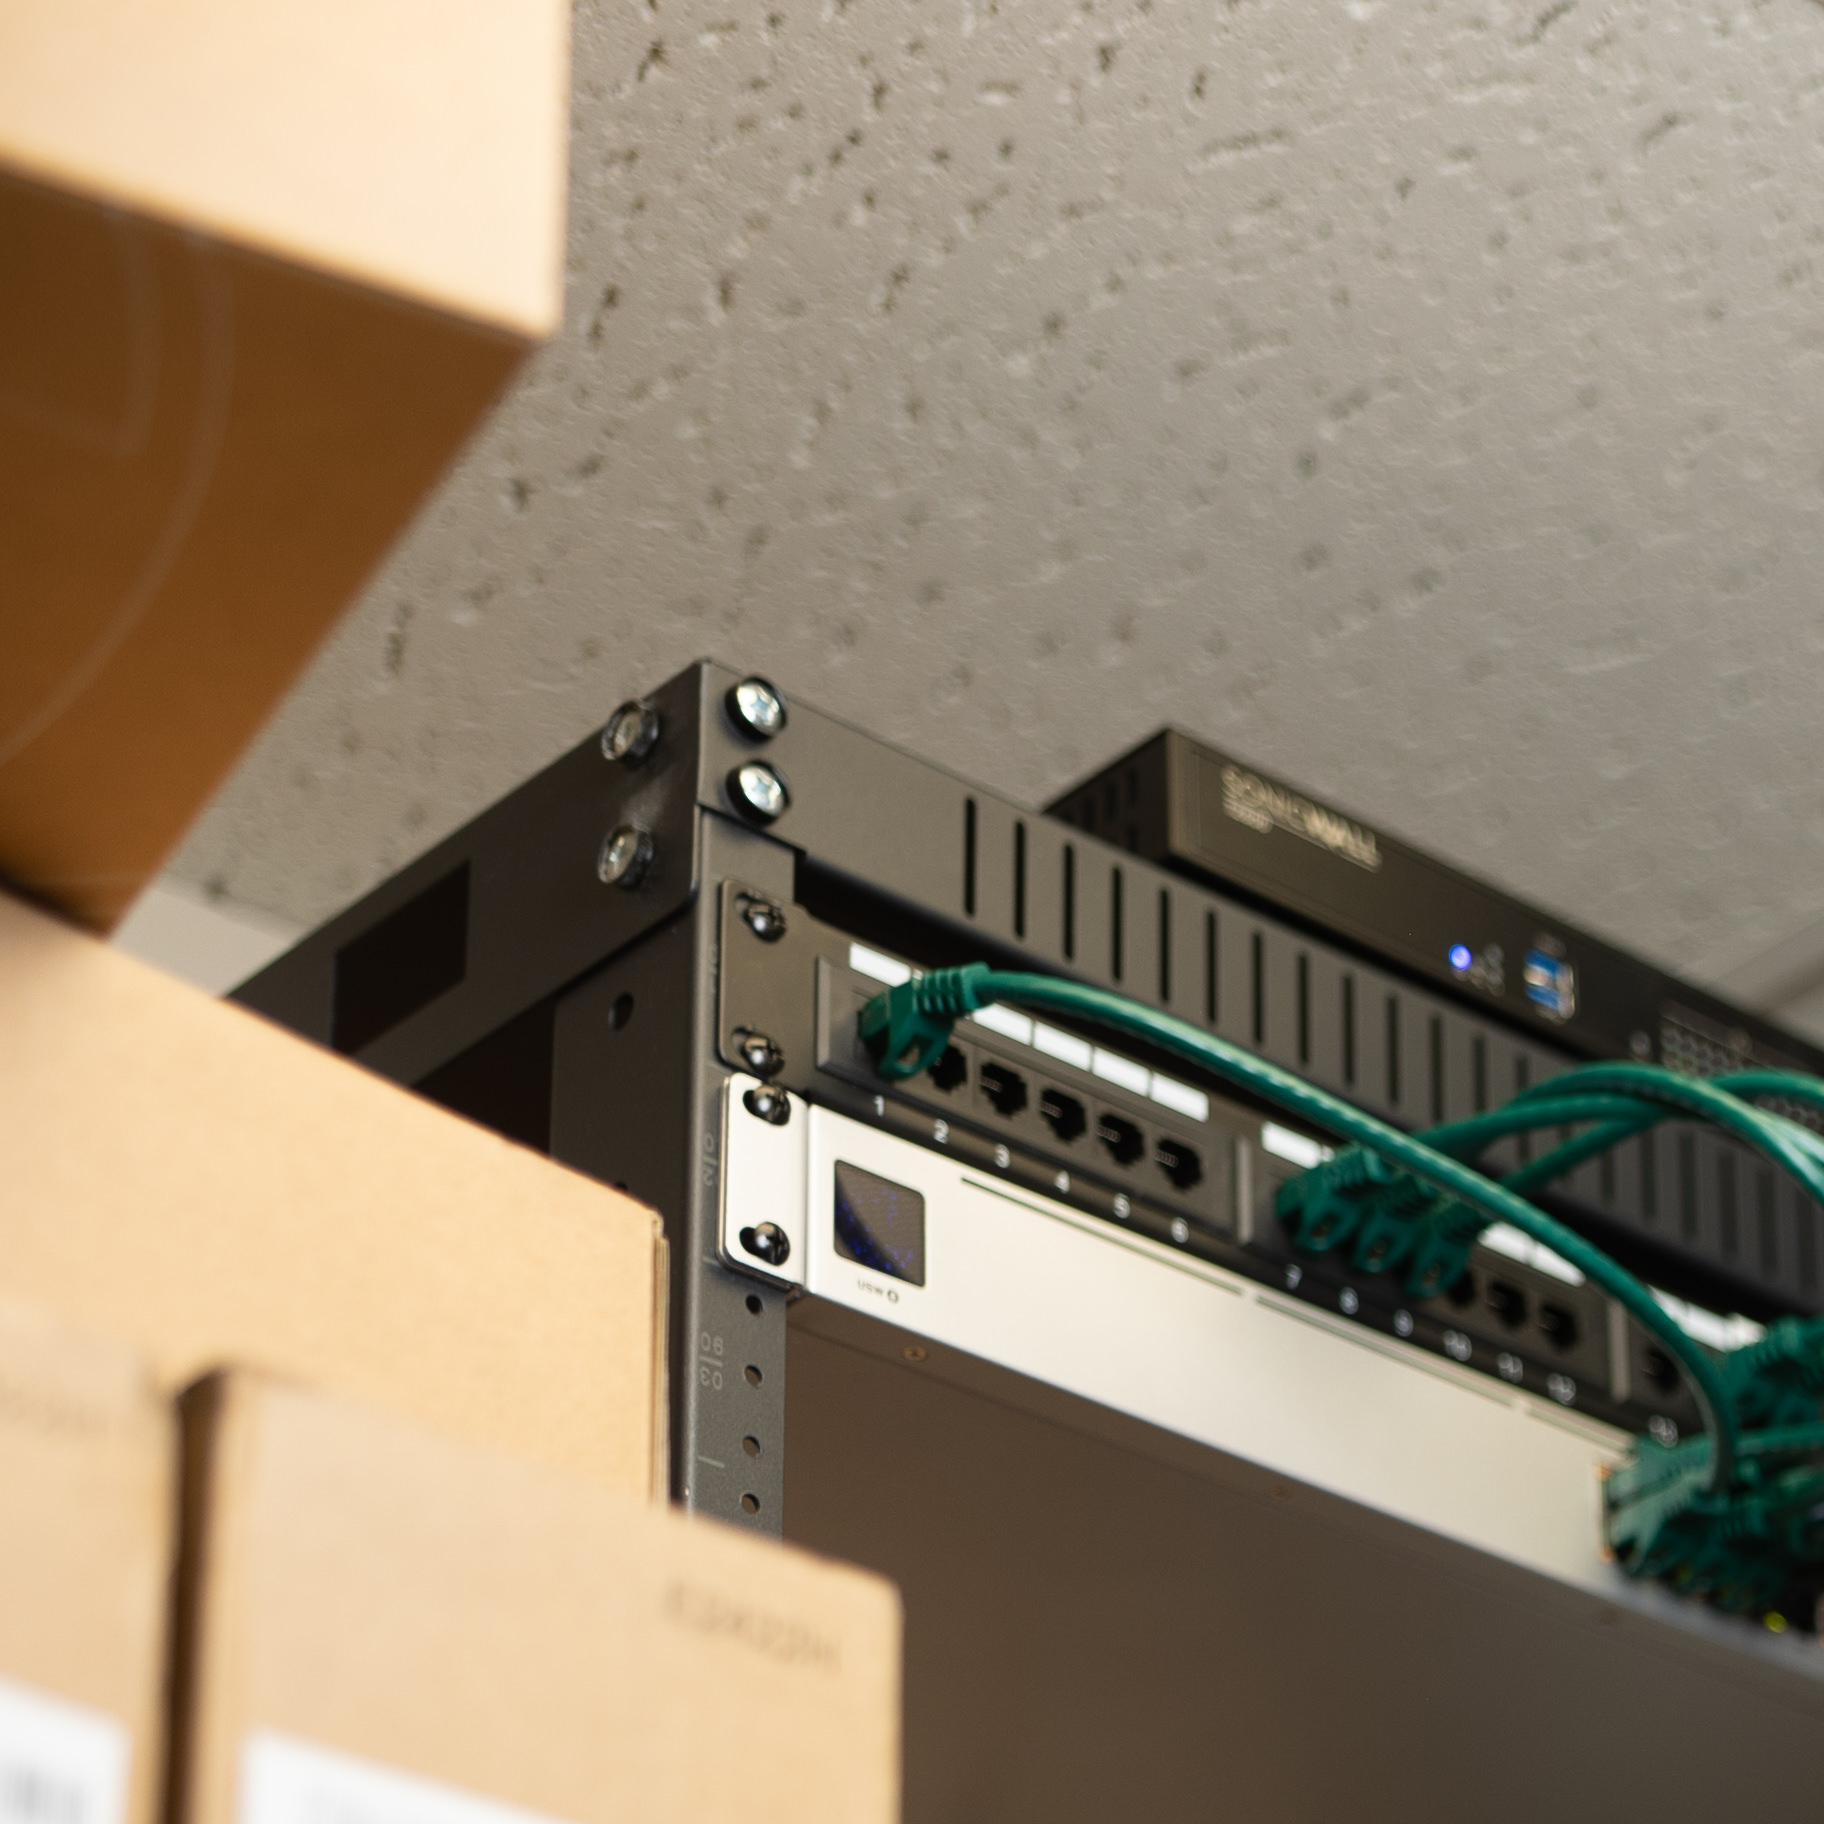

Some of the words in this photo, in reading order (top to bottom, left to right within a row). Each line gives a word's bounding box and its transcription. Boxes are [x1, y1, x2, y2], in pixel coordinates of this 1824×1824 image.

[874, 1095, 885, 1117] 1
[934, 1119, 948, 1144] 2
[996, 1144, 1010, 1168] 3
[1055, 1170, 1070, 1194] 4
[1114, 1193, 1130, 1219] 5
